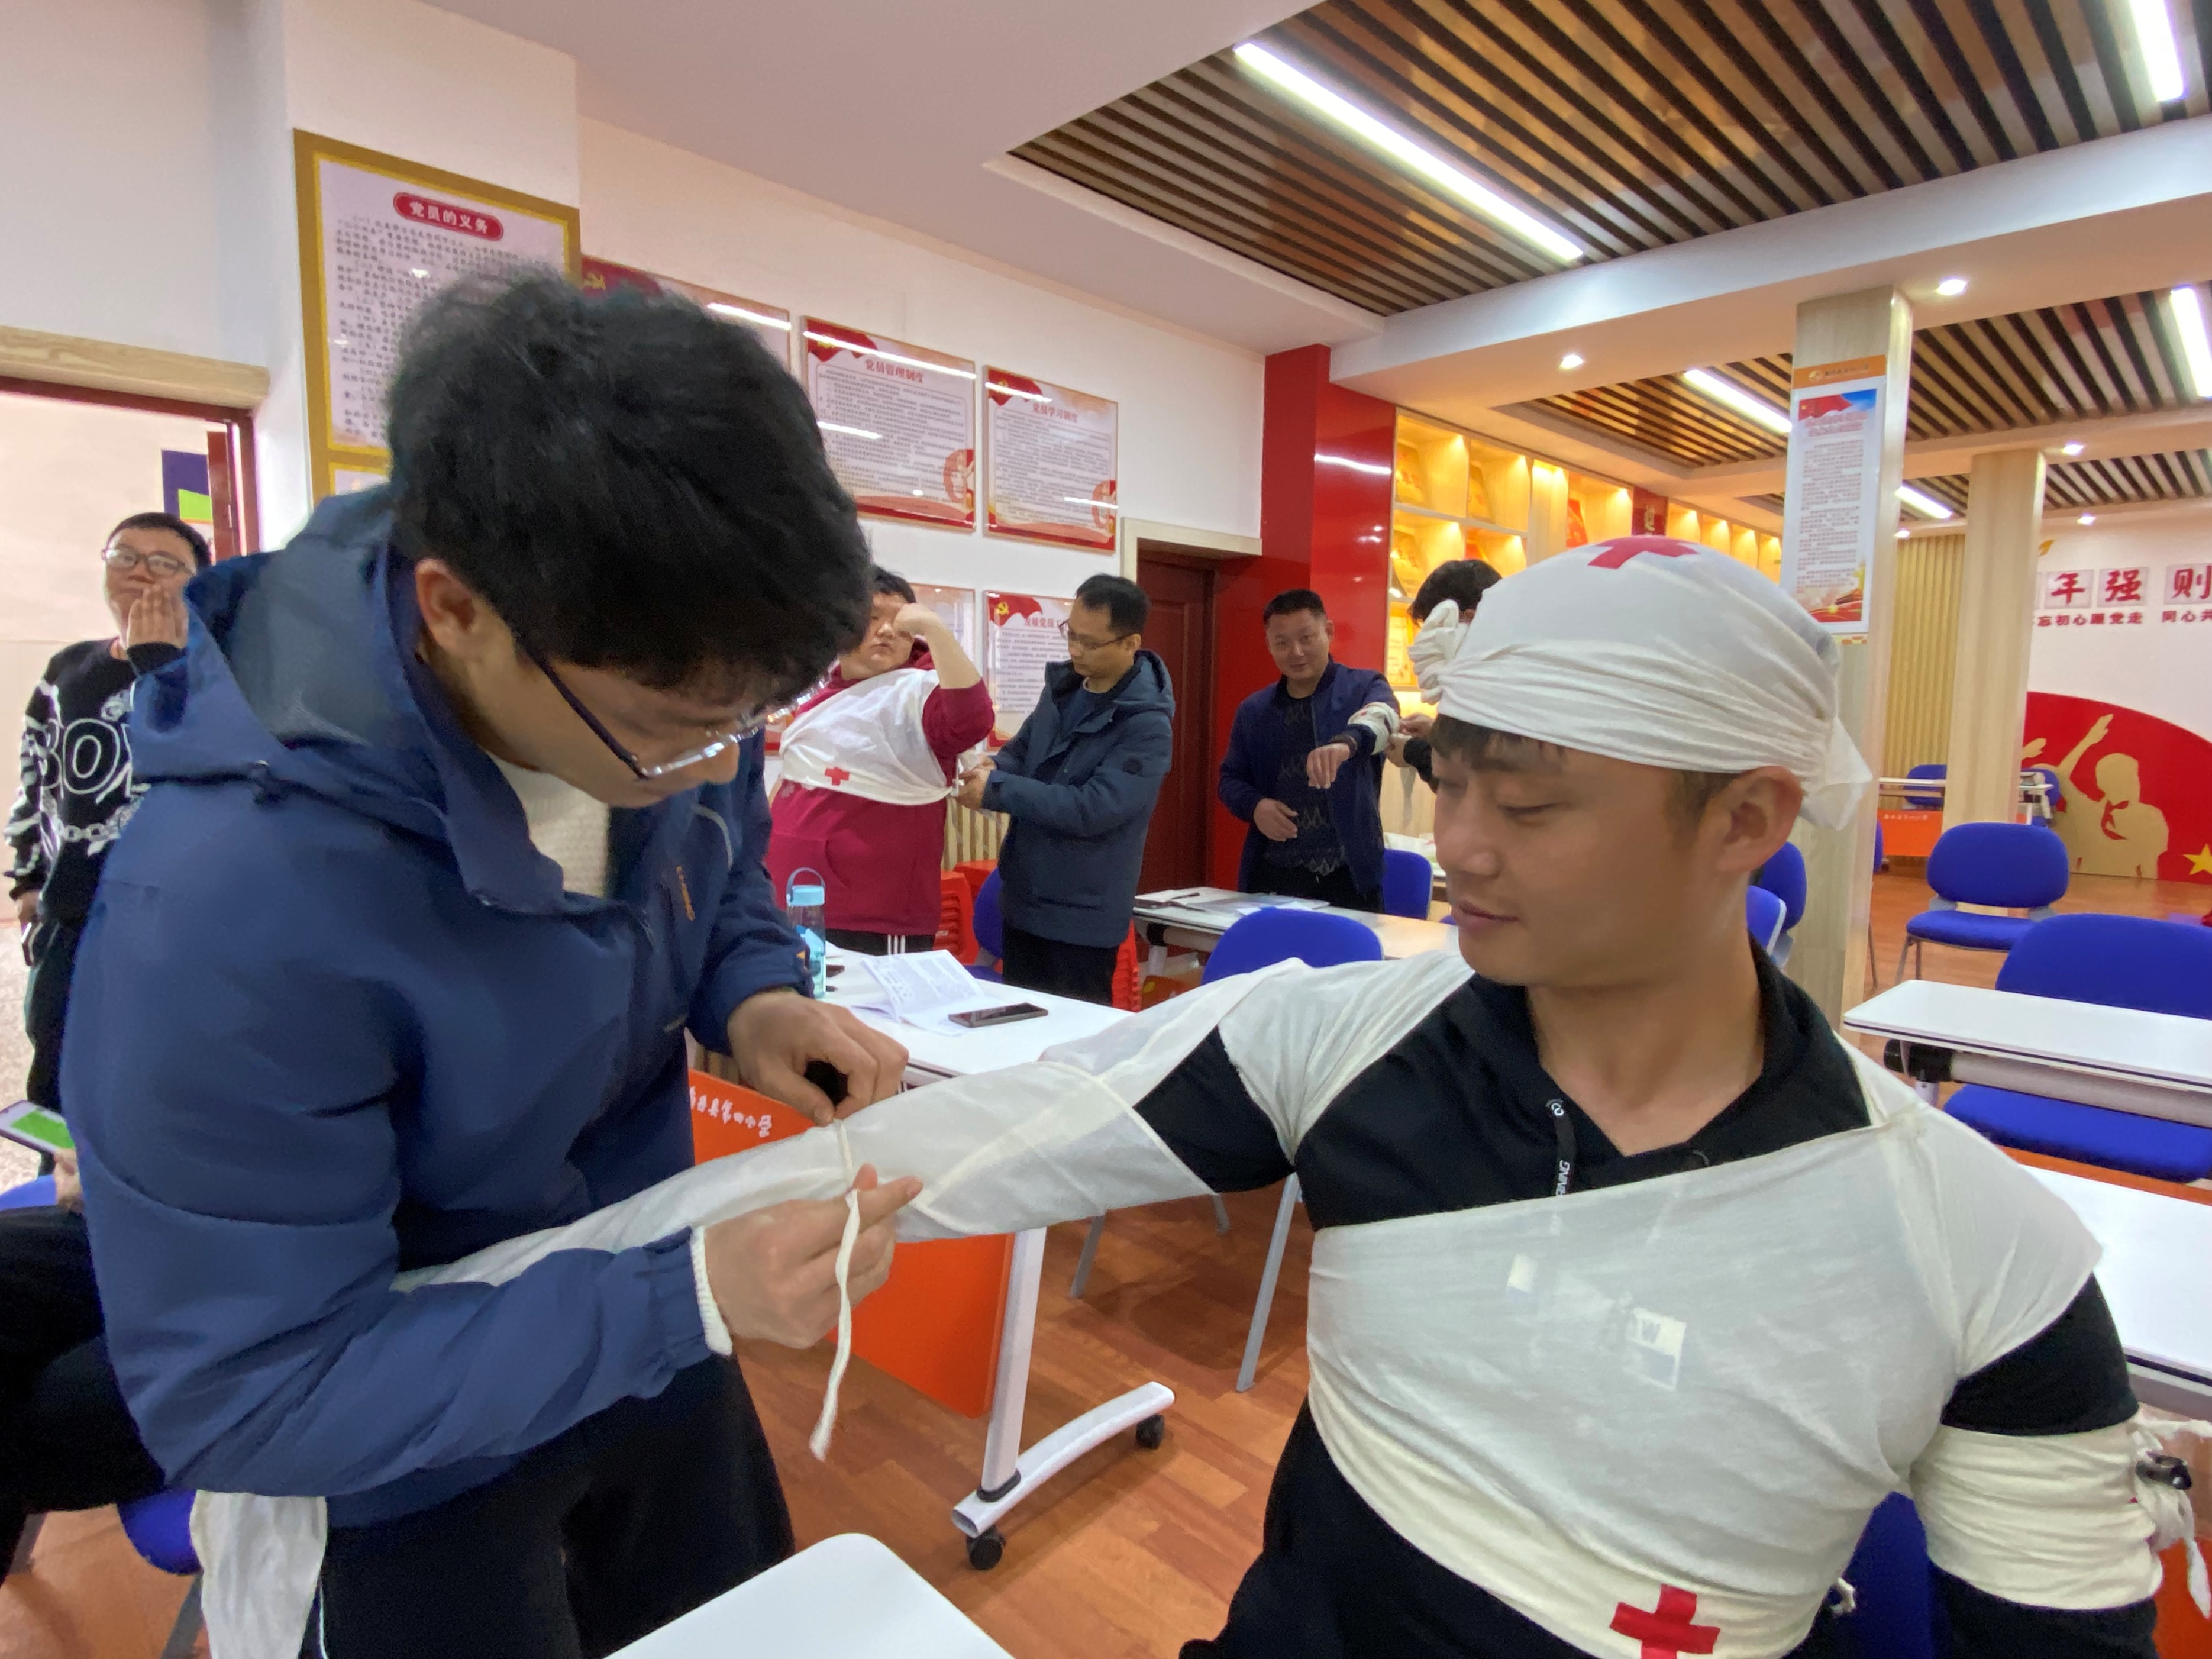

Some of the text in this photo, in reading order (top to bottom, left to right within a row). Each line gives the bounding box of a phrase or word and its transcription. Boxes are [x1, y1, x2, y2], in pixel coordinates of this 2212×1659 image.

[409, 201, 488, 234] 党员的义务
